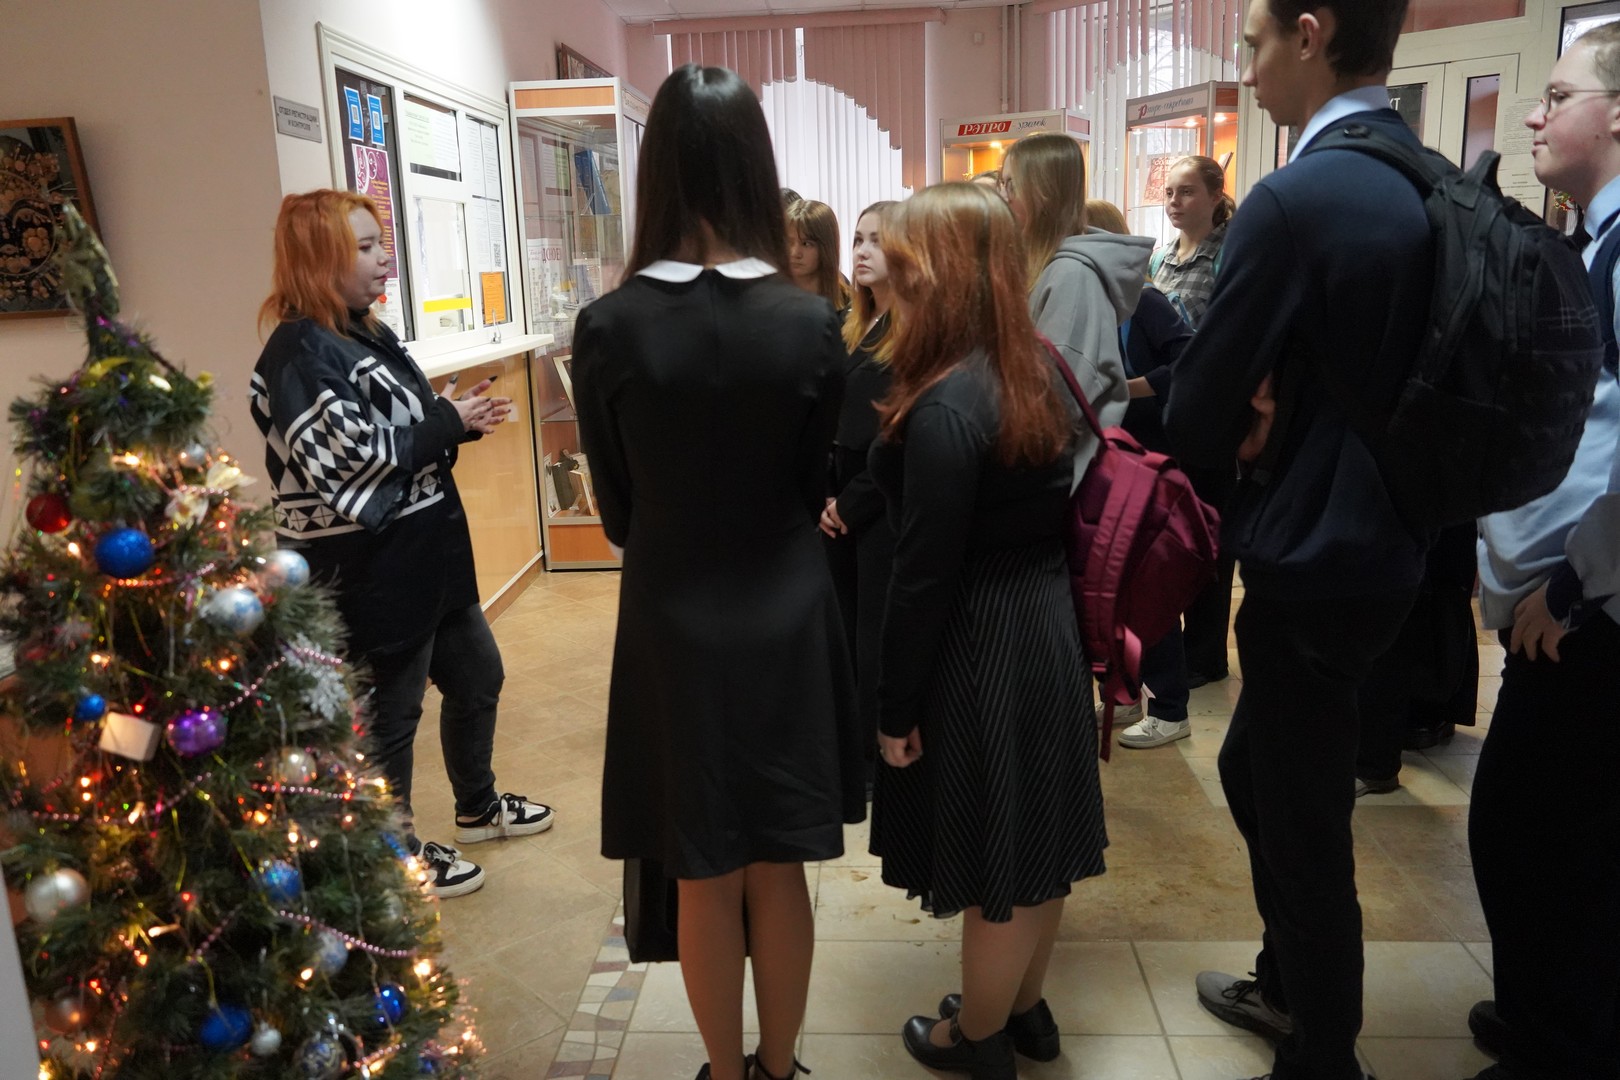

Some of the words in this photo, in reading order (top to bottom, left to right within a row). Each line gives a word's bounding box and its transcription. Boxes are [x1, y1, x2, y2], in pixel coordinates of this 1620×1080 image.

[278, 106, 291, 116] ОТДЕЛ
[291, 109, 318, 123] РЕГИСТРАЦИИ
[963, 122, 1006, 135] РЭТРО
